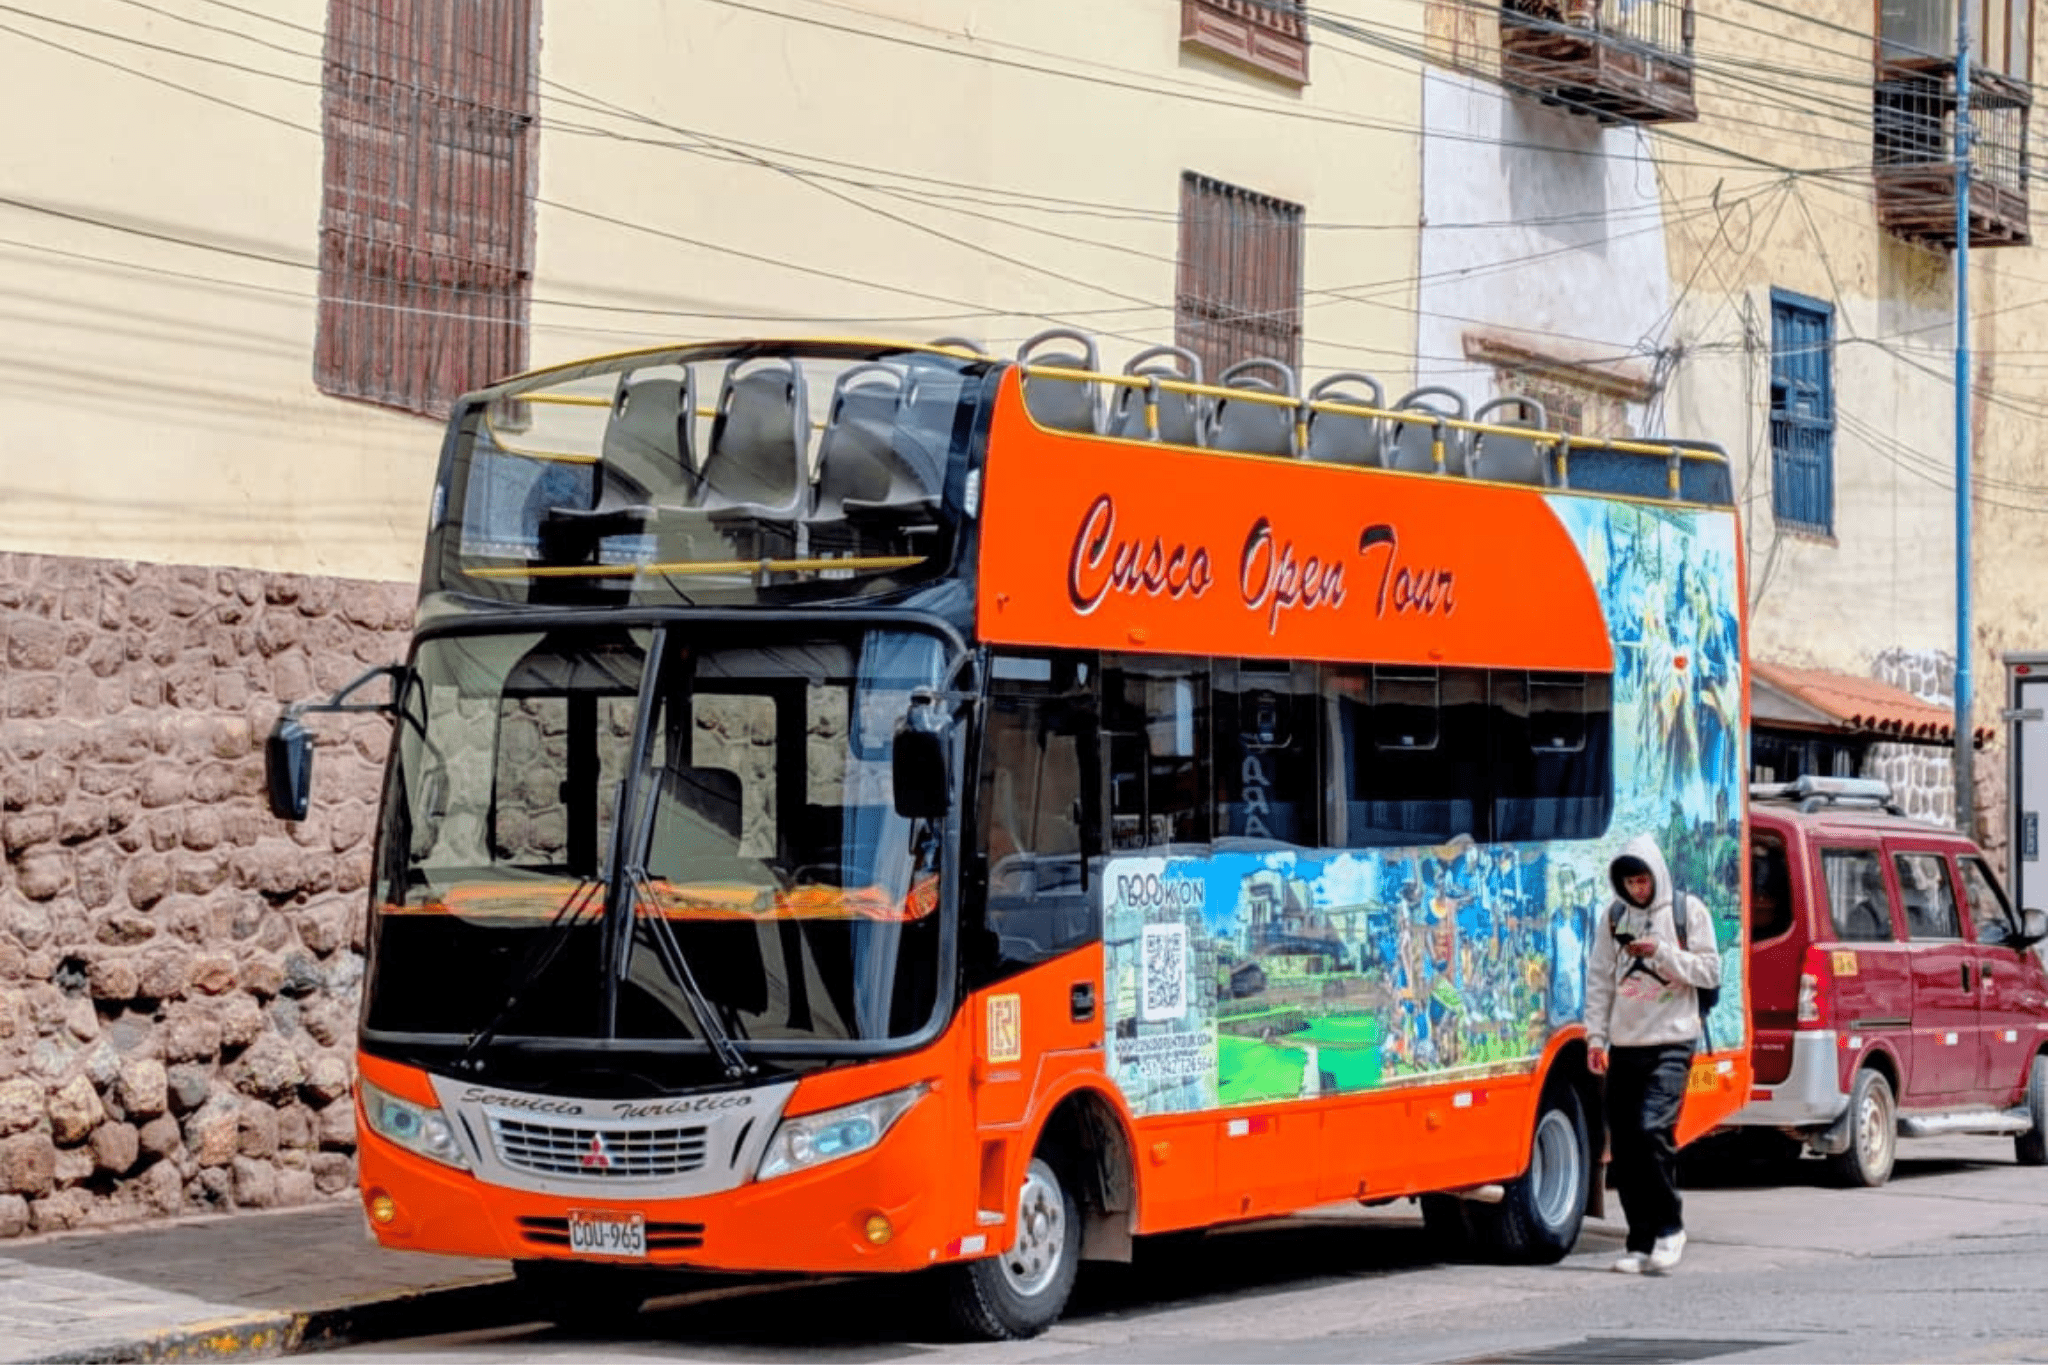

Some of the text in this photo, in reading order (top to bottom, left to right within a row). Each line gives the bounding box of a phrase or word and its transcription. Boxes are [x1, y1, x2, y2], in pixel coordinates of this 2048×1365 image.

[1068, 492, 1457, 637] Cusco Open Tour
[459, 1087, 583, 1116] Servicio
